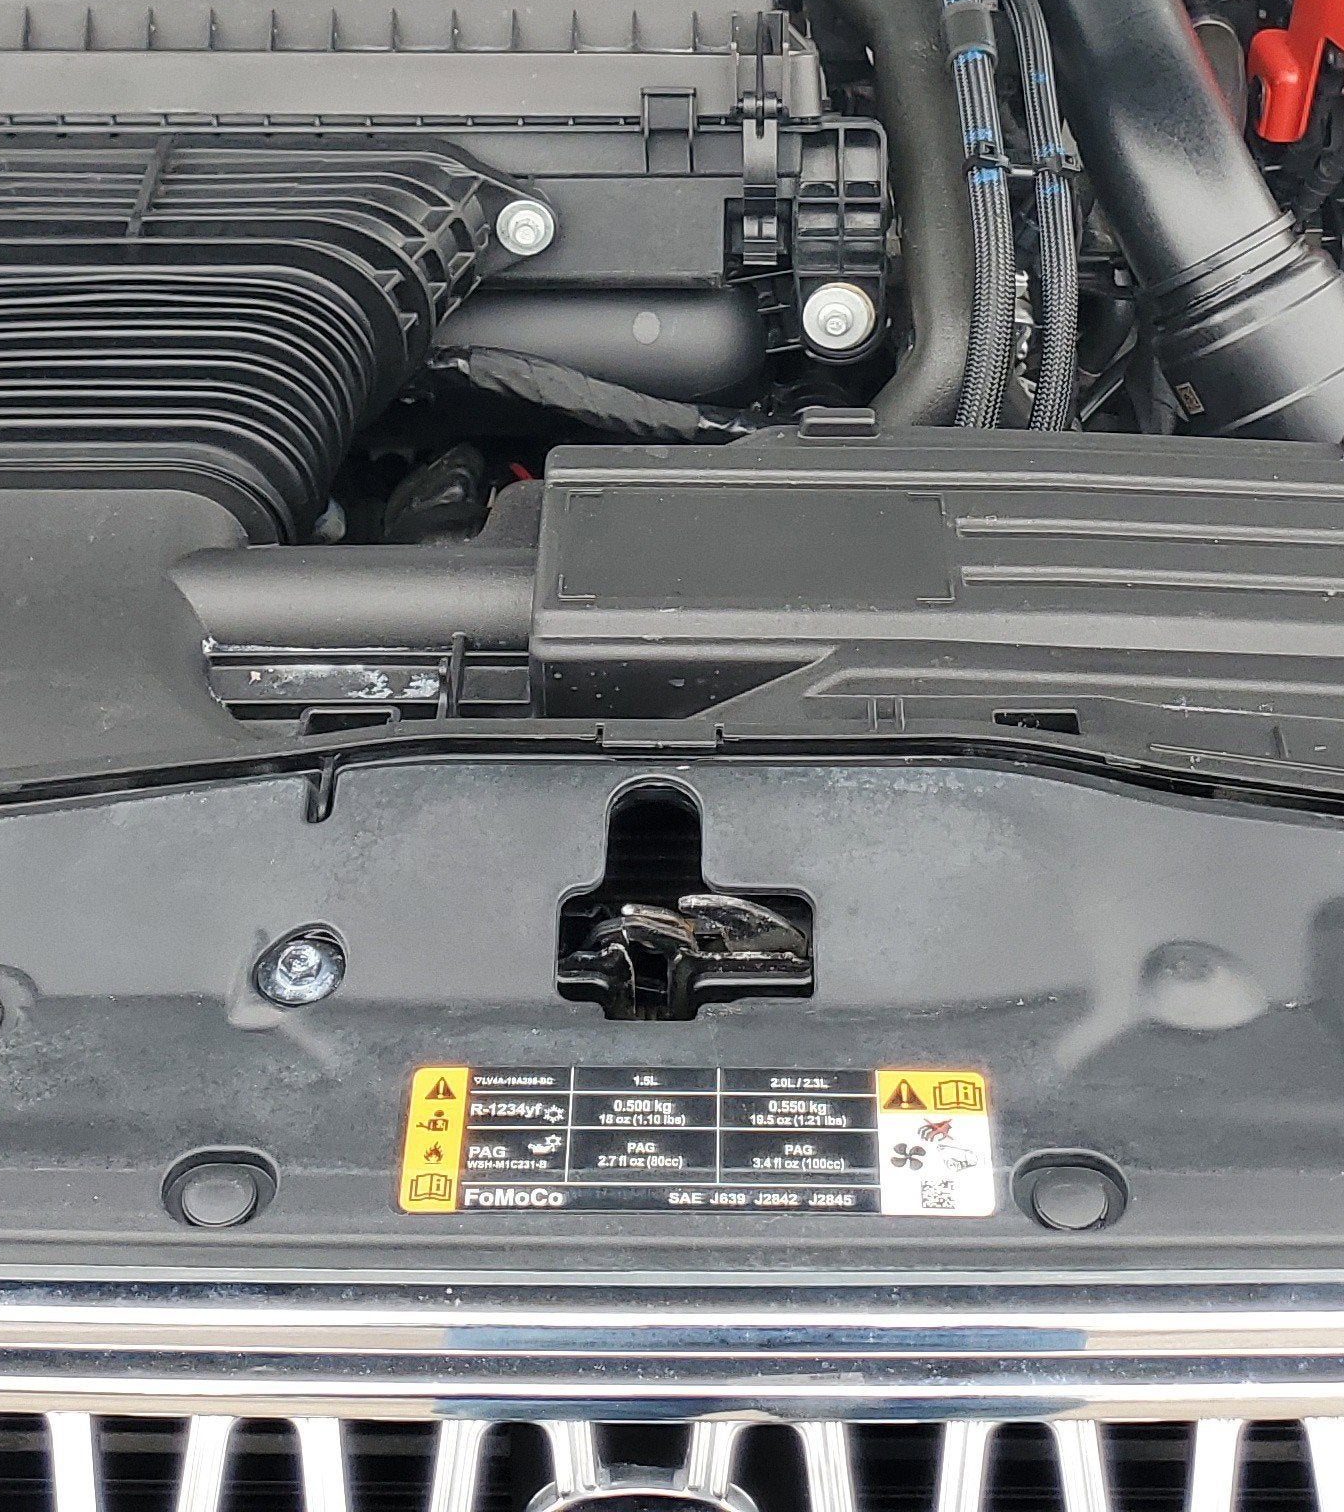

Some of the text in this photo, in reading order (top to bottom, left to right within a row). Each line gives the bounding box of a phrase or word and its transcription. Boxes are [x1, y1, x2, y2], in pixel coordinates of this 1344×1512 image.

[633, 1075, 659, 1086] 1.5L
[770, 1077, 796, 1088] 2.0L
[803, 1078, 830, 1088] 2.3L
[471, 1102, 543, 1118] R-1234yf
[613, 1099, 672, 1114] 0.500 kg
[768, 1100, 827, 1115] 0.550 kg
[616, 1115, 632, 1125] oz
[663, 1114, 686, 1126] lbs)
[776, 1115, 792, 1125] oz
[793, 1114, 821, 1127] (1.21
[824, 1114, 847, 1127] lbs)
[469, 1145, 507, 1158] PAG
[627, 1142, 656, 1153] PAG
[784, 1144, 813, 1155] PAG
[597, 1155, 683, 1169] 2.7 fl oz (80cc)
[752, 1157, 845, 1171] 3.4 fl oz (100cc)
[464, 1188, 564, 1206] FoMoCo
[668, 1192, 854, 1206] SAE J639 J2842 J2845
